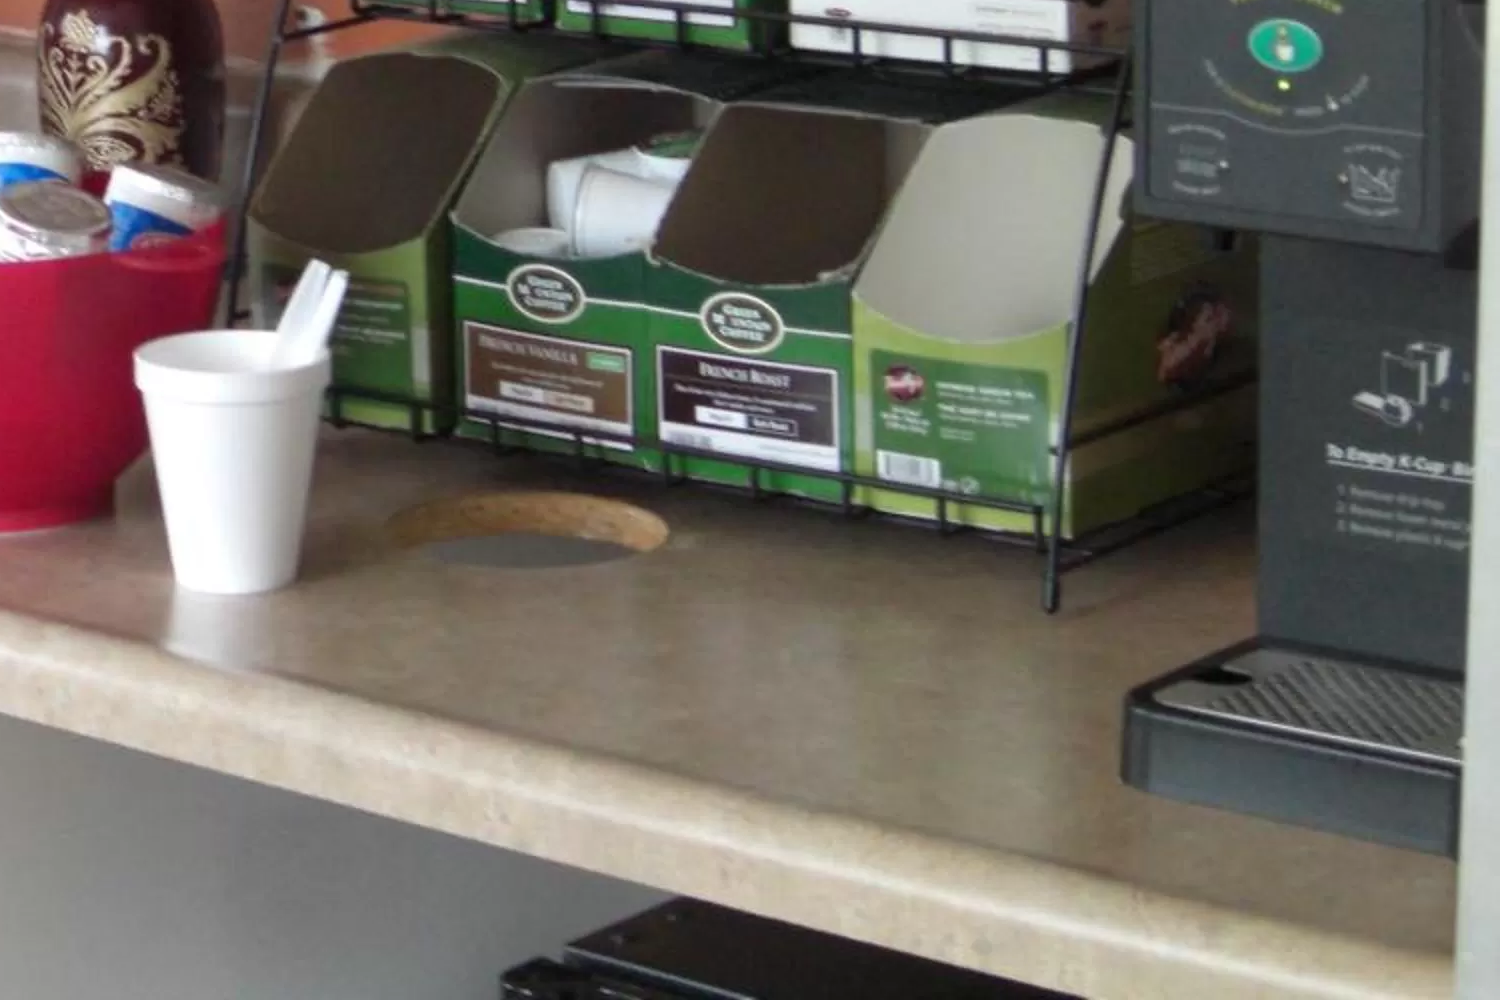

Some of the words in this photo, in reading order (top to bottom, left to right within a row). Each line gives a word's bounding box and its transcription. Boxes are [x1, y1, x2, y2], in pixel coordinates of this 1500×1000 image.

[699, 360, 749, 383] FRENCH
[750, 368, 792, 389] ROAST
[1346, 446, 1394, 470] Empty
